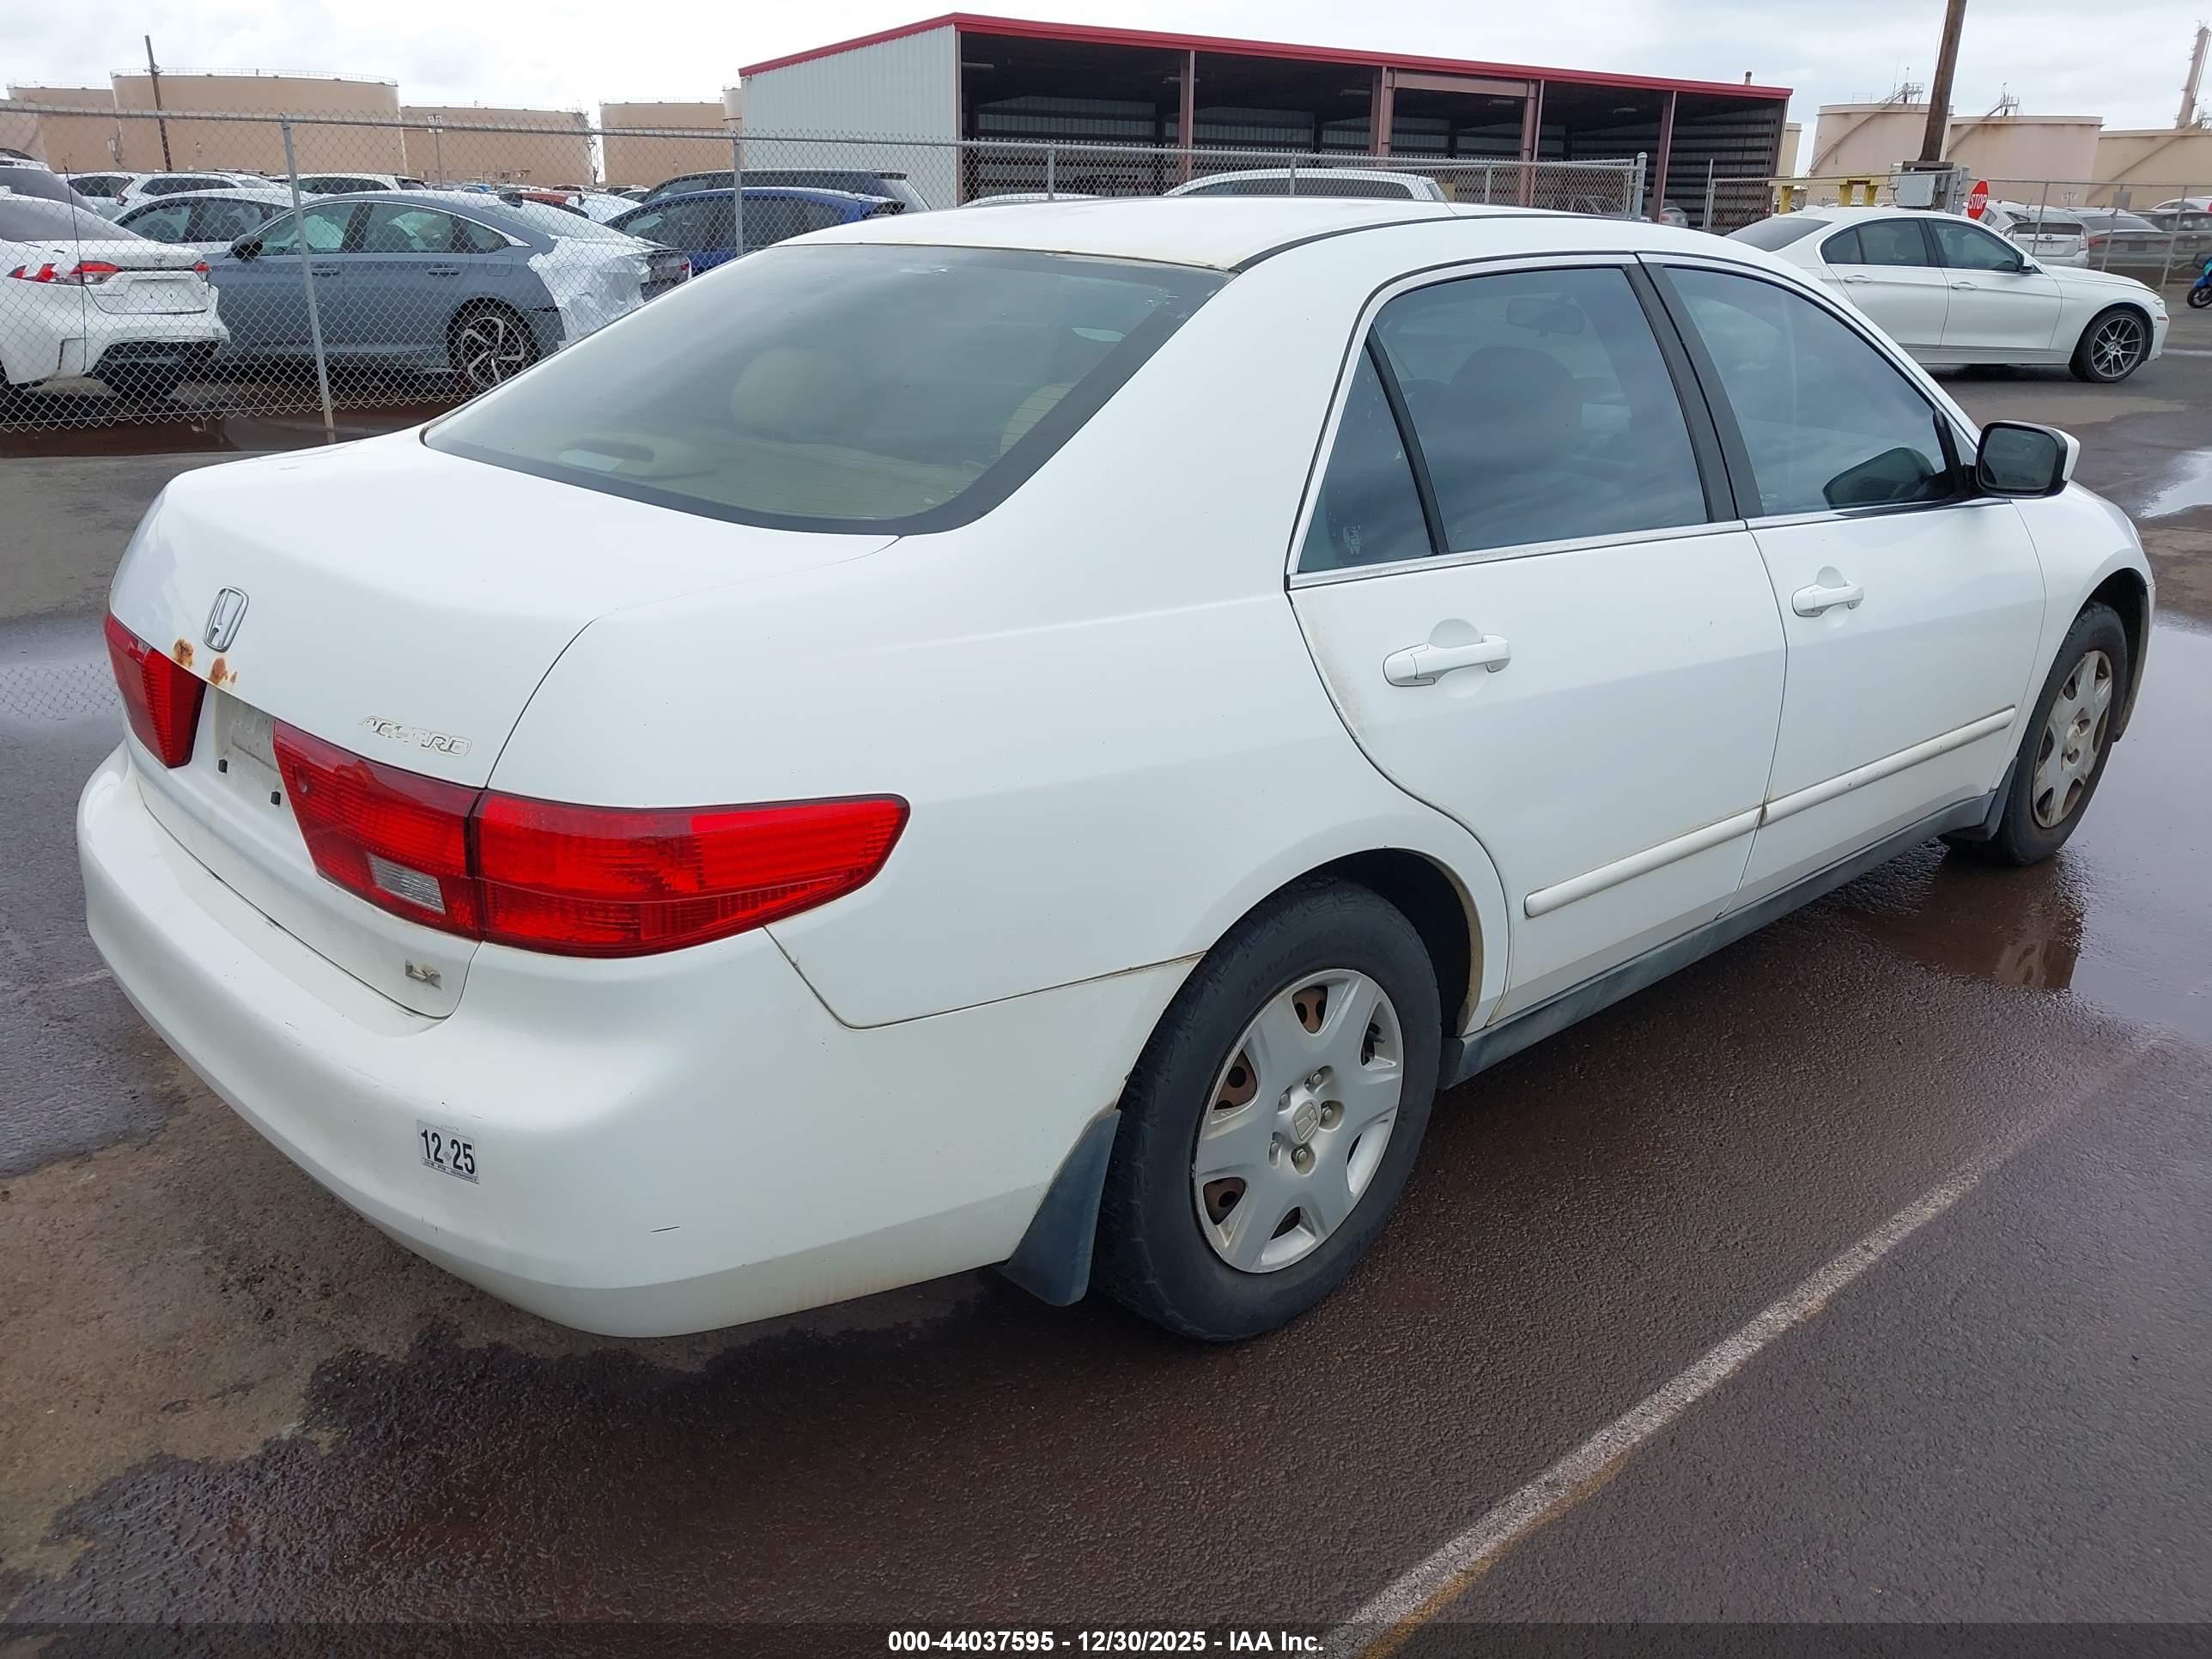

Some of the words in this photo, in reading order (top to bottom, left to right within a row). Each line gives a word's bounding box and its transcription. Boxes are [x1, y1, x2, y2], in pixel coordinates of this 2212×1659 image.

[1969, 193, 1988, 210] STOP
[404, 959, 441, 989] LX
[421, 1128, 444, 1164] 12
[450, 1139, 476, 1175] 25
